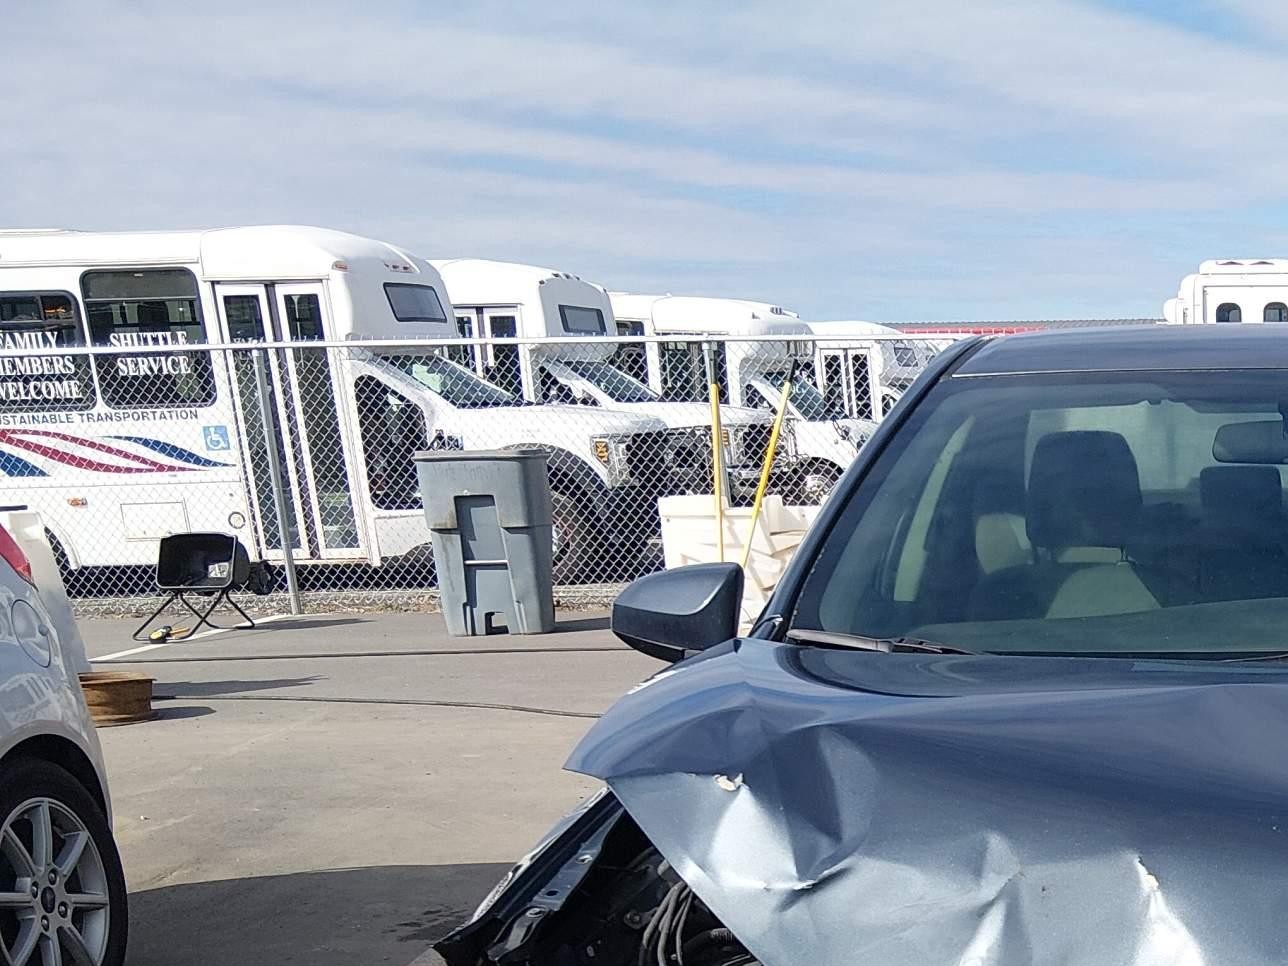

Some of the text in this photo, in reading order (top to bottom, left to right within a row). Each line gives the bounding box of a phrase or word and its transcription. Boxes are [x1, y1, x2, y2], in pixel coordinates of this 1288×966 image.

[109, 331, 187, 348] SHUTTLE
[117, 356, 191, 377] SERVICE
[80, 409, 198, 423] TRANSPORTATION
